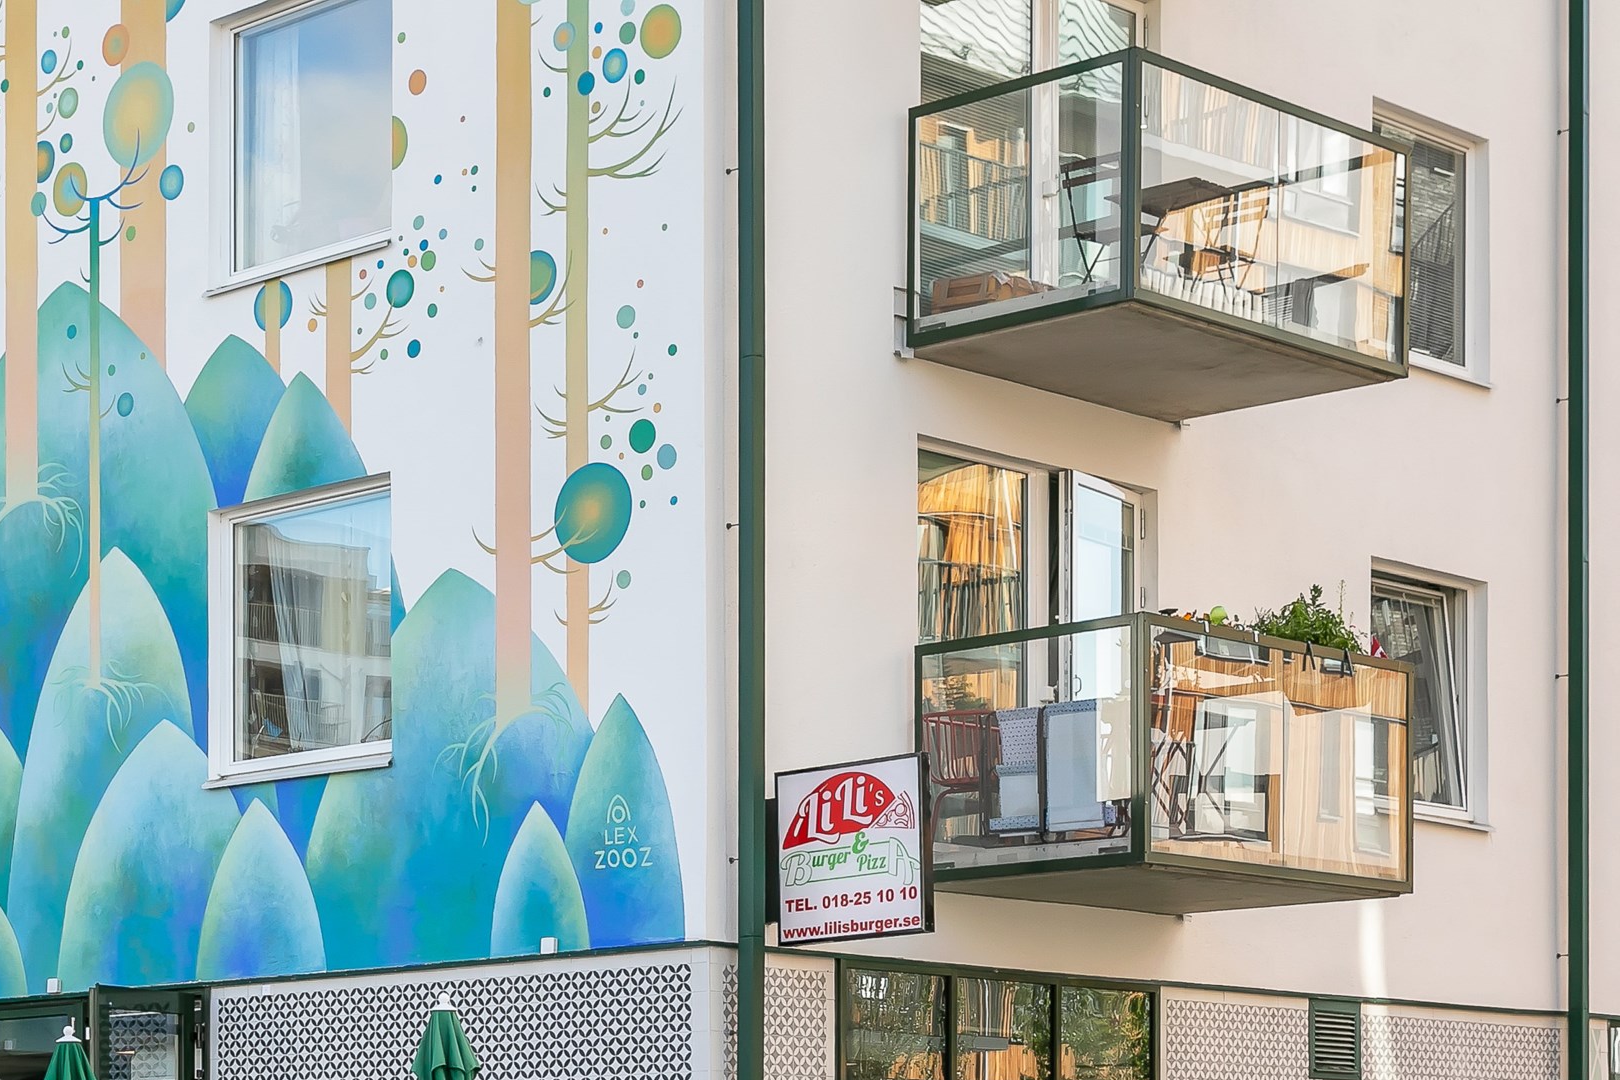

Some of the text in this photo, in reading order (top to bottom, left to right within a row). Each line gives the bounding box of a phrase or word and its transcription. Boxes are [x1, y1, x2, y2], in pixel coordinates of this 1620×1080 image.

[797, 775, 885, 845] LiLi's
[594, 846, 653, 870] ZOOZ
[781, 850, 851, 887] Burger
[852, 831, 869, 854] &
[785, 886, 918, 913] TEL. 018-25 10 10
[783, 915, 921, 939] www.lilisburger.se
